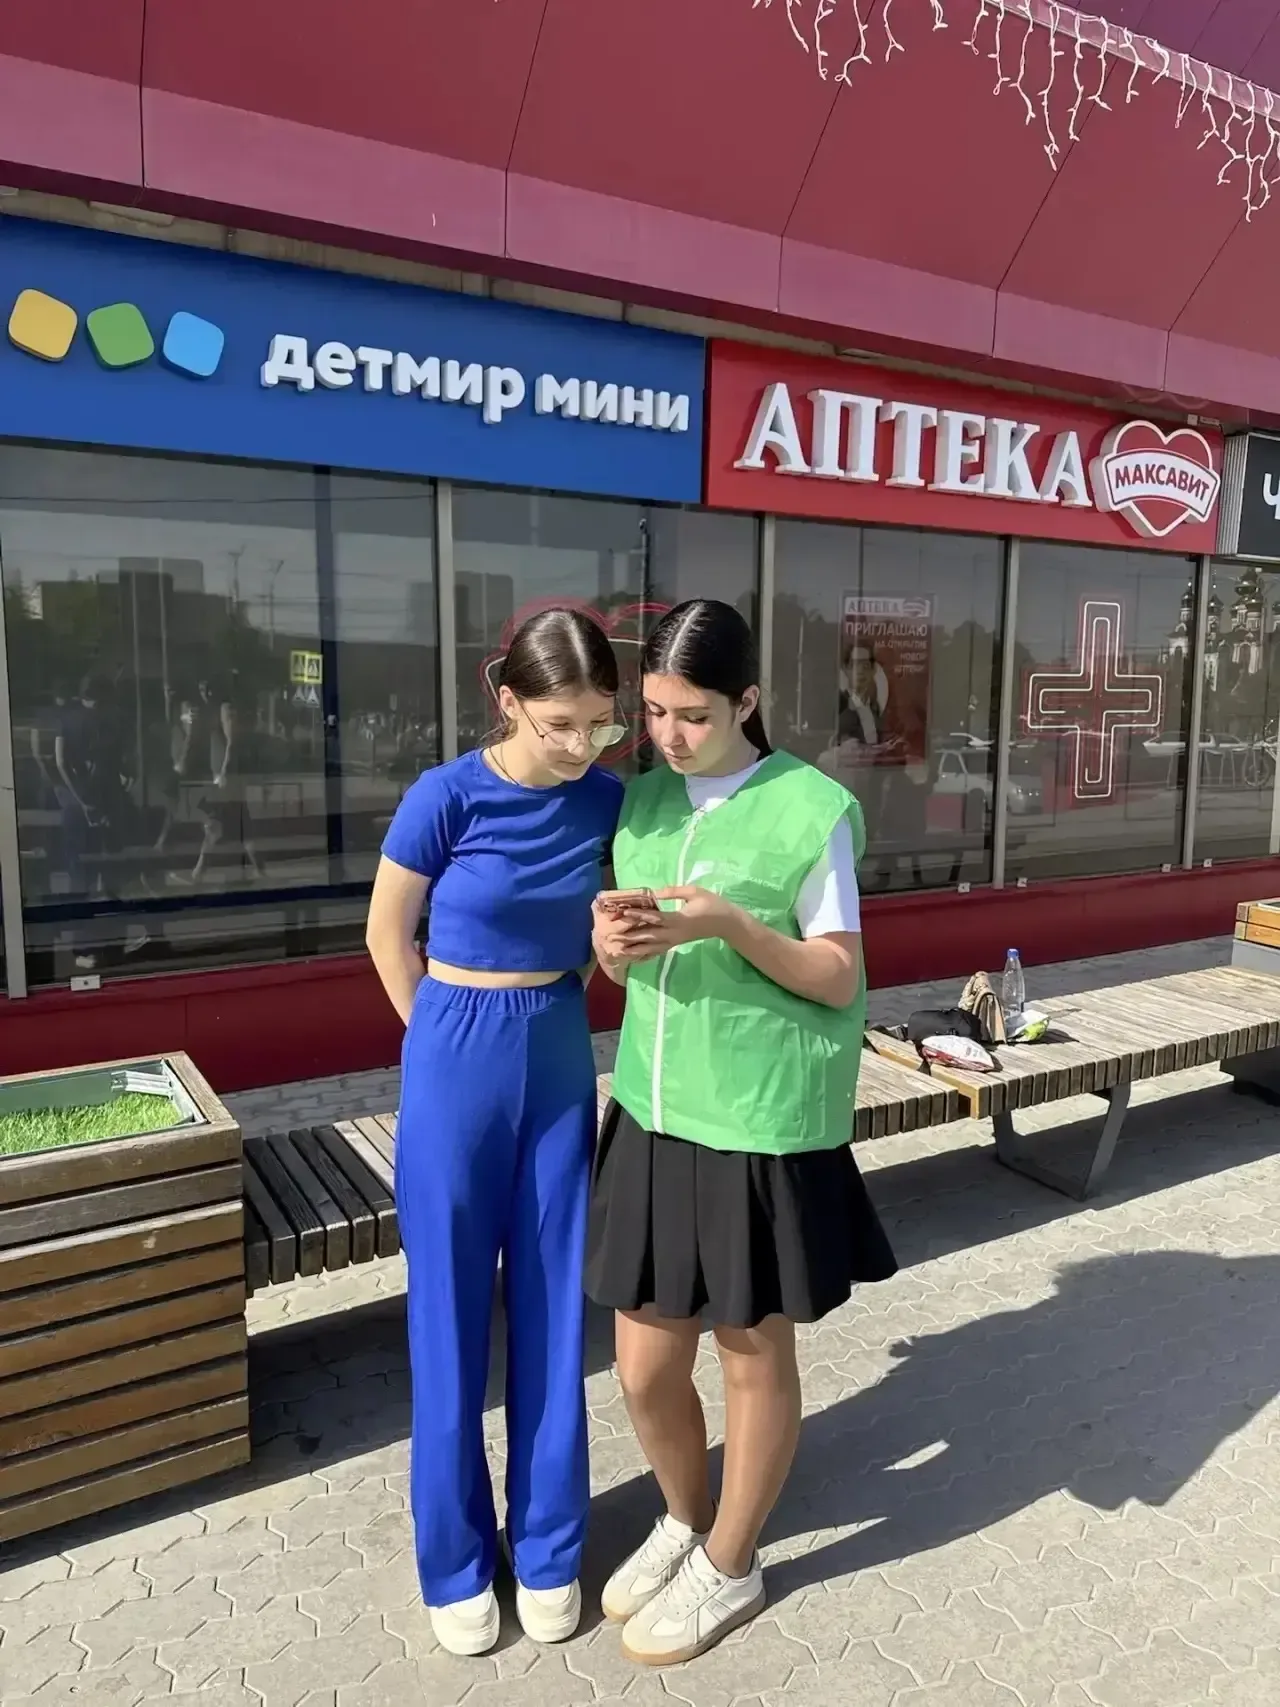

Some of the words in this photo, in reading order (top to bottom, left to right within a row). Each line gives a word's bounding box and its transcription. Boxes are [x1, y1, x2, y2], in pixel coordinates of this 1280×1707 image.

[260, 333, 526, 424] детмир
[534, 372, 690, 432] мини
[733, 382, 1093, 508] АПТЕКА
[1114, 463, 1210, 502] МАКСАВИТ
[848, 600, 900, 613] АПТЕКА
[845, 622, 928, 637] ПРИГЛАШАЮ
